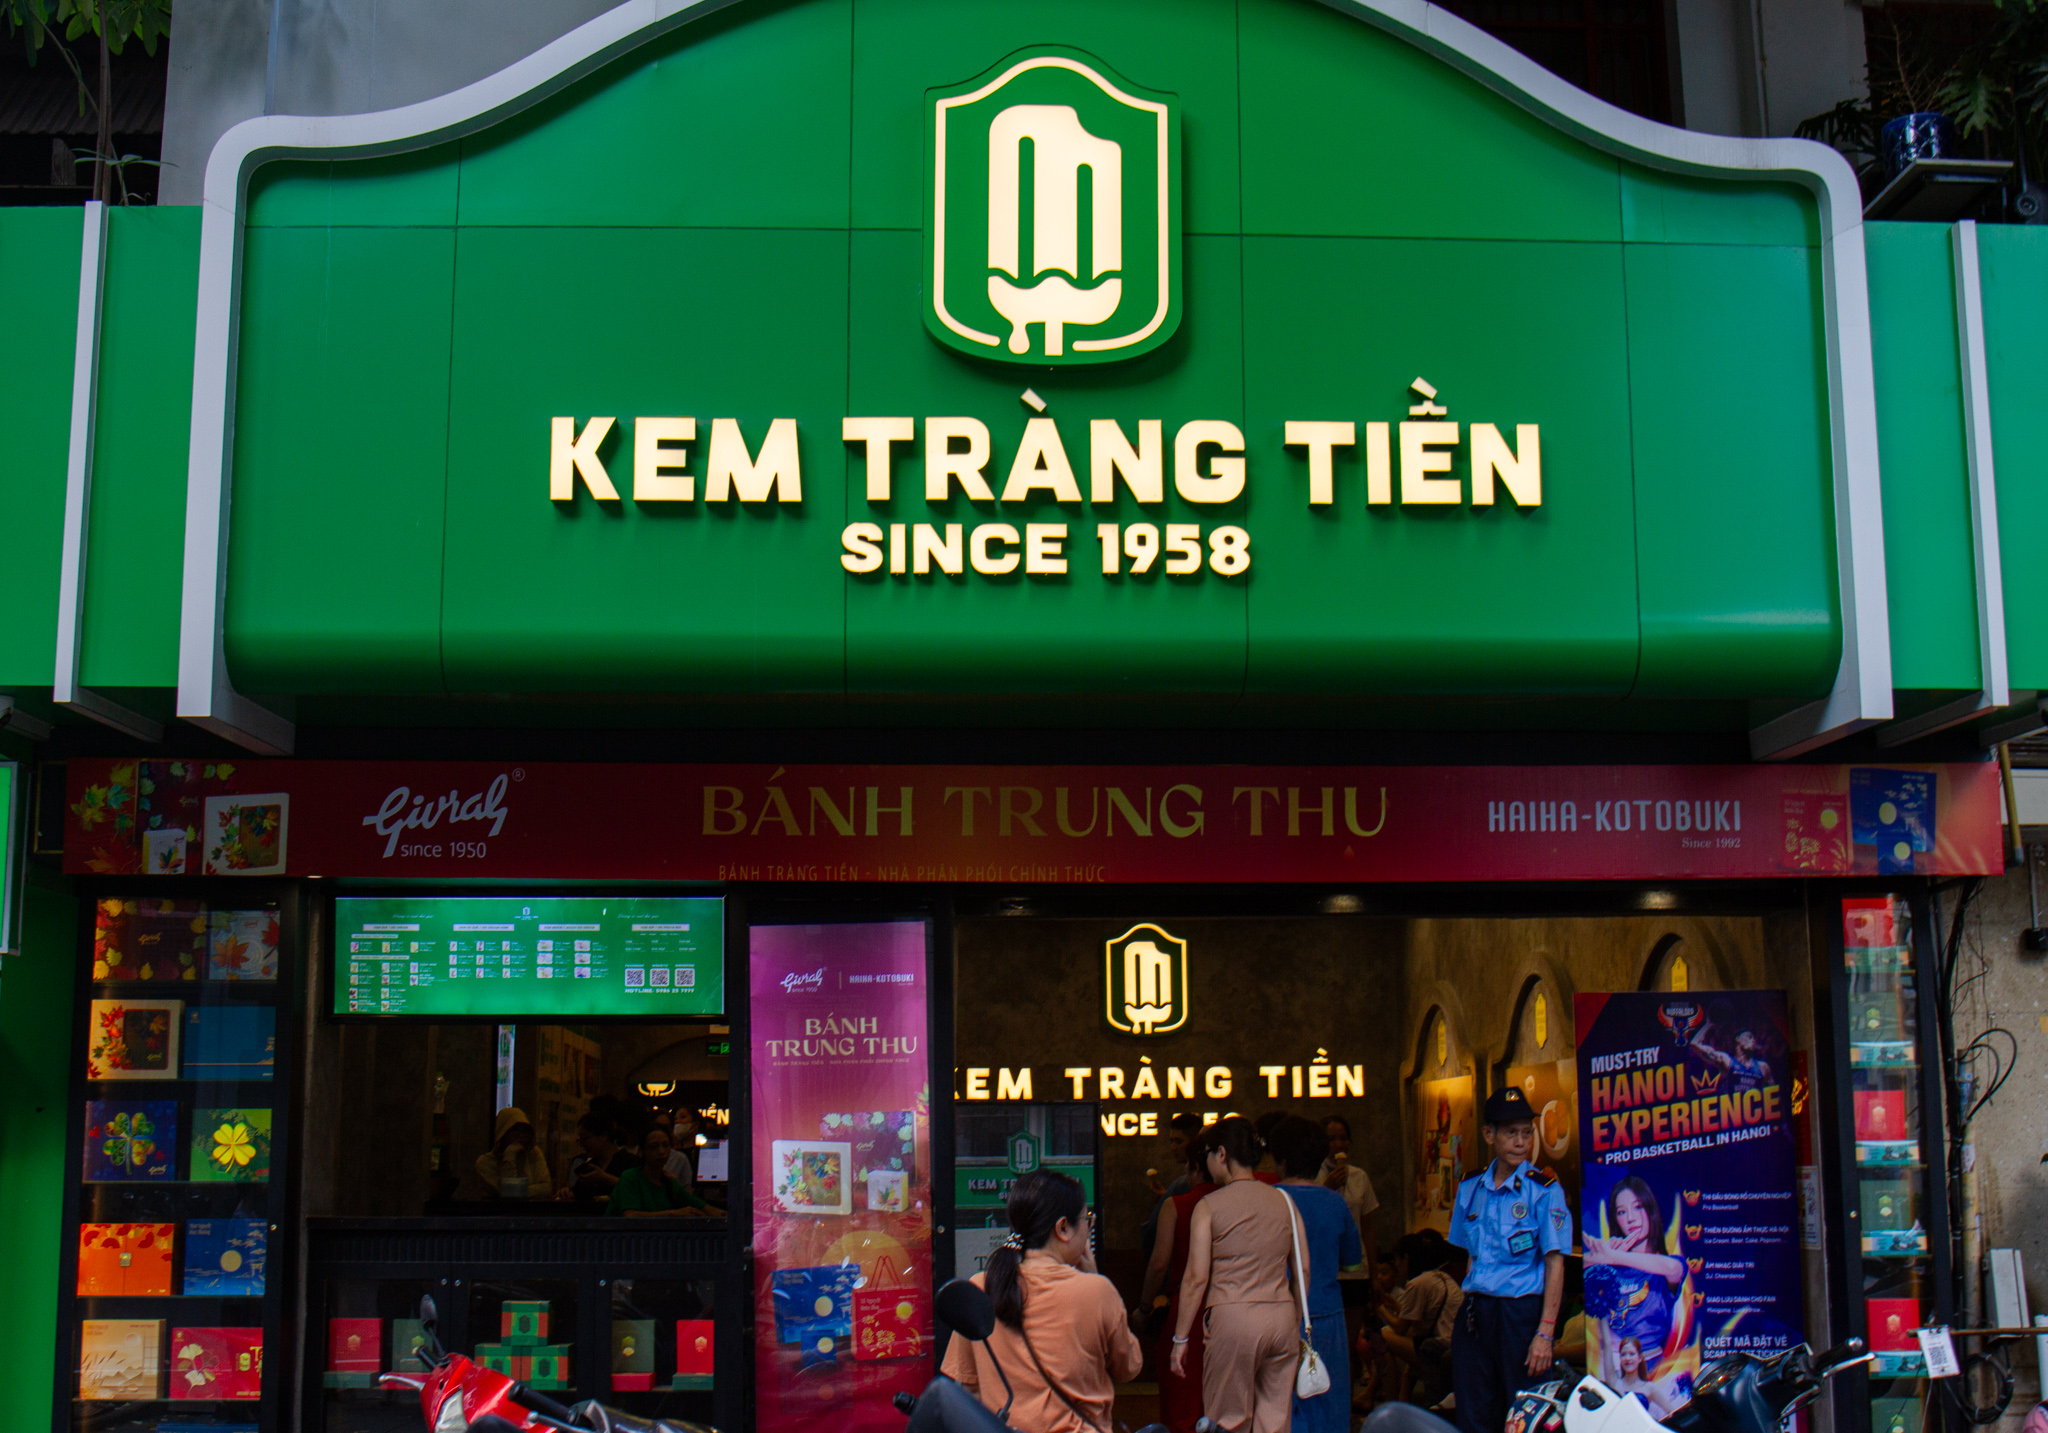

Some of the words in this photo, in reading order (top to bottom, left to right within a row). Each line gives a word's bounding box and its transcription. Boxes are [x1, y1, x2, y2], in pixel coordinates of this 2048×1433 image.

[550, 416, 802, 502] KEM
[842, 387, 1245, 503] TRÀNG
[1284, 376, 1541, 506] TIỀN
[841, 522, 1067, 574] SINCE
[1097, 523, 1250, 576] 1958
[362, 773, 508, 858] Givral
[702, 766, 914, 836] BÁNH
[943, 784, 1204, 838] TRUNG
[1232, 787, 1386, 837] THU
[1488, 800, 1741, 832] HAIHA-KOTOBUKI
[401, 842, 441, 858] since
[450, 842, 486, 859] 1950
[1682, 837, 1712, 849] Since
[1715, 837, 1741, 849] 1992
[718, 862, 760, 881] BÁNH
[805, 1012, 878, 1036] BÁNH
[765, 1037, 855, 1057] TRUNG
[863, 1036, 917, 1055] THU
[1591, 1045, 1660, 1075] MUST-TRY
[1065, 1055, 1233, 1100] TRÀNG
[1259, 1047, 1365, 1098] TIỀN
[1591, 1063, 1685, 1113] HANOI
[1592, 1084, 1782, 1151] EXPERIENCE
[1605, 1152, 1631, 1165] PRO
[1632, 1138, 1715, 1159] BASKETBALL
[1717, 1132, 1730, 1145] IN
[1731, 1125, 1771, 1142] HANOI
[968, 1178, 997, 1190] KEM
[1705, 1335, 1731, 1350] QUÉT
[1734, 1334, 1750, 1347] MÃ
[1752, 1334, 1773, 1349] ĐẶT
[1774, 1333, 1788, 1347] VÉ
